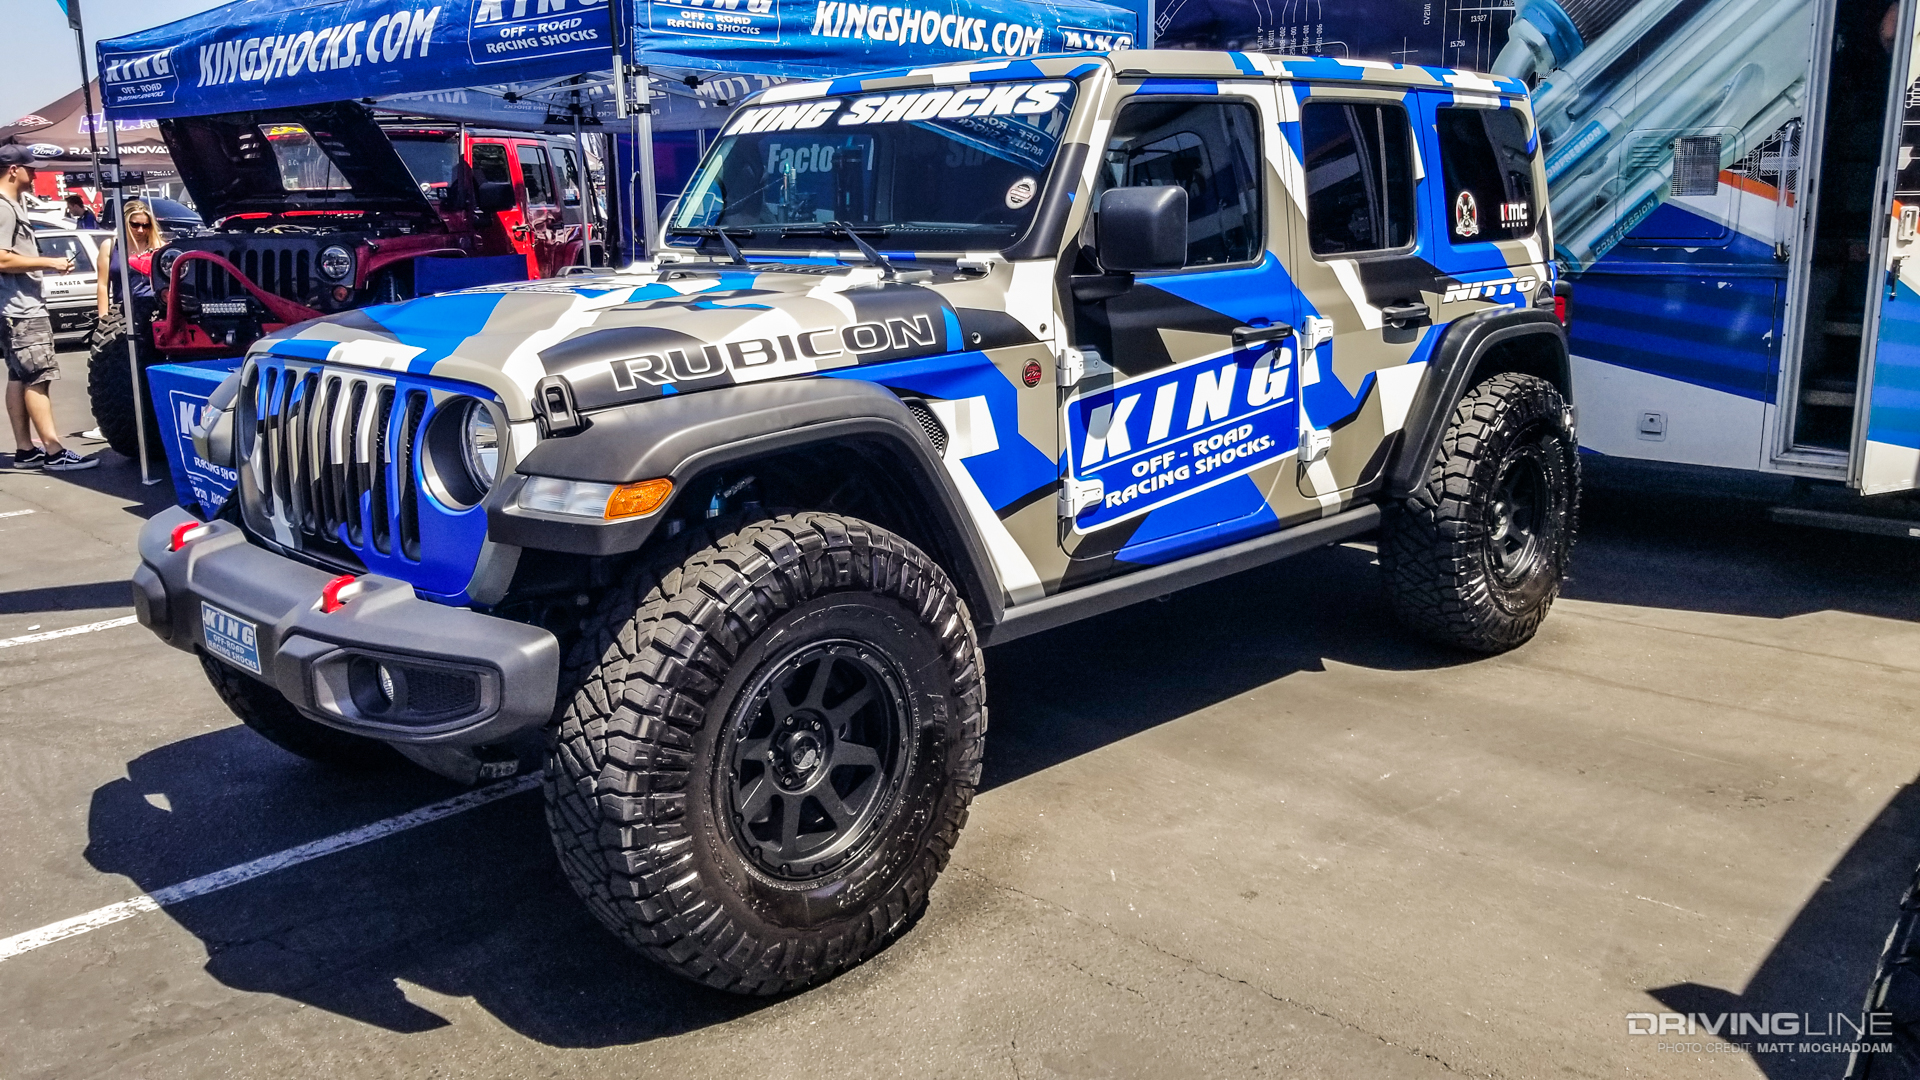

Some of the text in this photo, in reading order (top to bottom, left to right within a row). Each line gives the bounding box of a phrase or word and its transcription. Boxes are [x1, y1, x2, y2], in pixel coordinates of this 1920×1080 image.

[500, 26, 527, 38] OFF
[537, 18, 582, 33] ROAD
[667, 19, 760, 35] RACING SHOCKS
[681, 11, 705, 20] OFF
[715, 14, 751, 25] ROAD
[811, 1, 1043, 56] KINGSHOCKS.COM
[197, 6, 441, 87] KINGSHOCKS.COM
[486, 29, 598, 54] RACING SHOCKS
[140, 83, 162, 92] ROAD
[723, 100, 842, 137] KING
[837, 82, 1072, 126] SHOCKS
[32, 146, 58, 154] Ford
[768, 143, 874, 174] Facto
[1546, 127, 1602, 176] OMPRESSION
[1500, 203, 1527, 221] KMC
[1442, 276, 1536, 304] NITTO
[610, 314, 937, 392] RUBICON
[1081, 347, 1292, 468] KING
[1132, 451, 1175, 477] OFF
[1193, 424, 1253, 457] ROAD
[221, 467, 237, 481] SHO
[1105, 465, 1190, 508] RACING
[204, 608, 254, 646] KING
[208, 640, 257, 669] RACING SHOCKS
